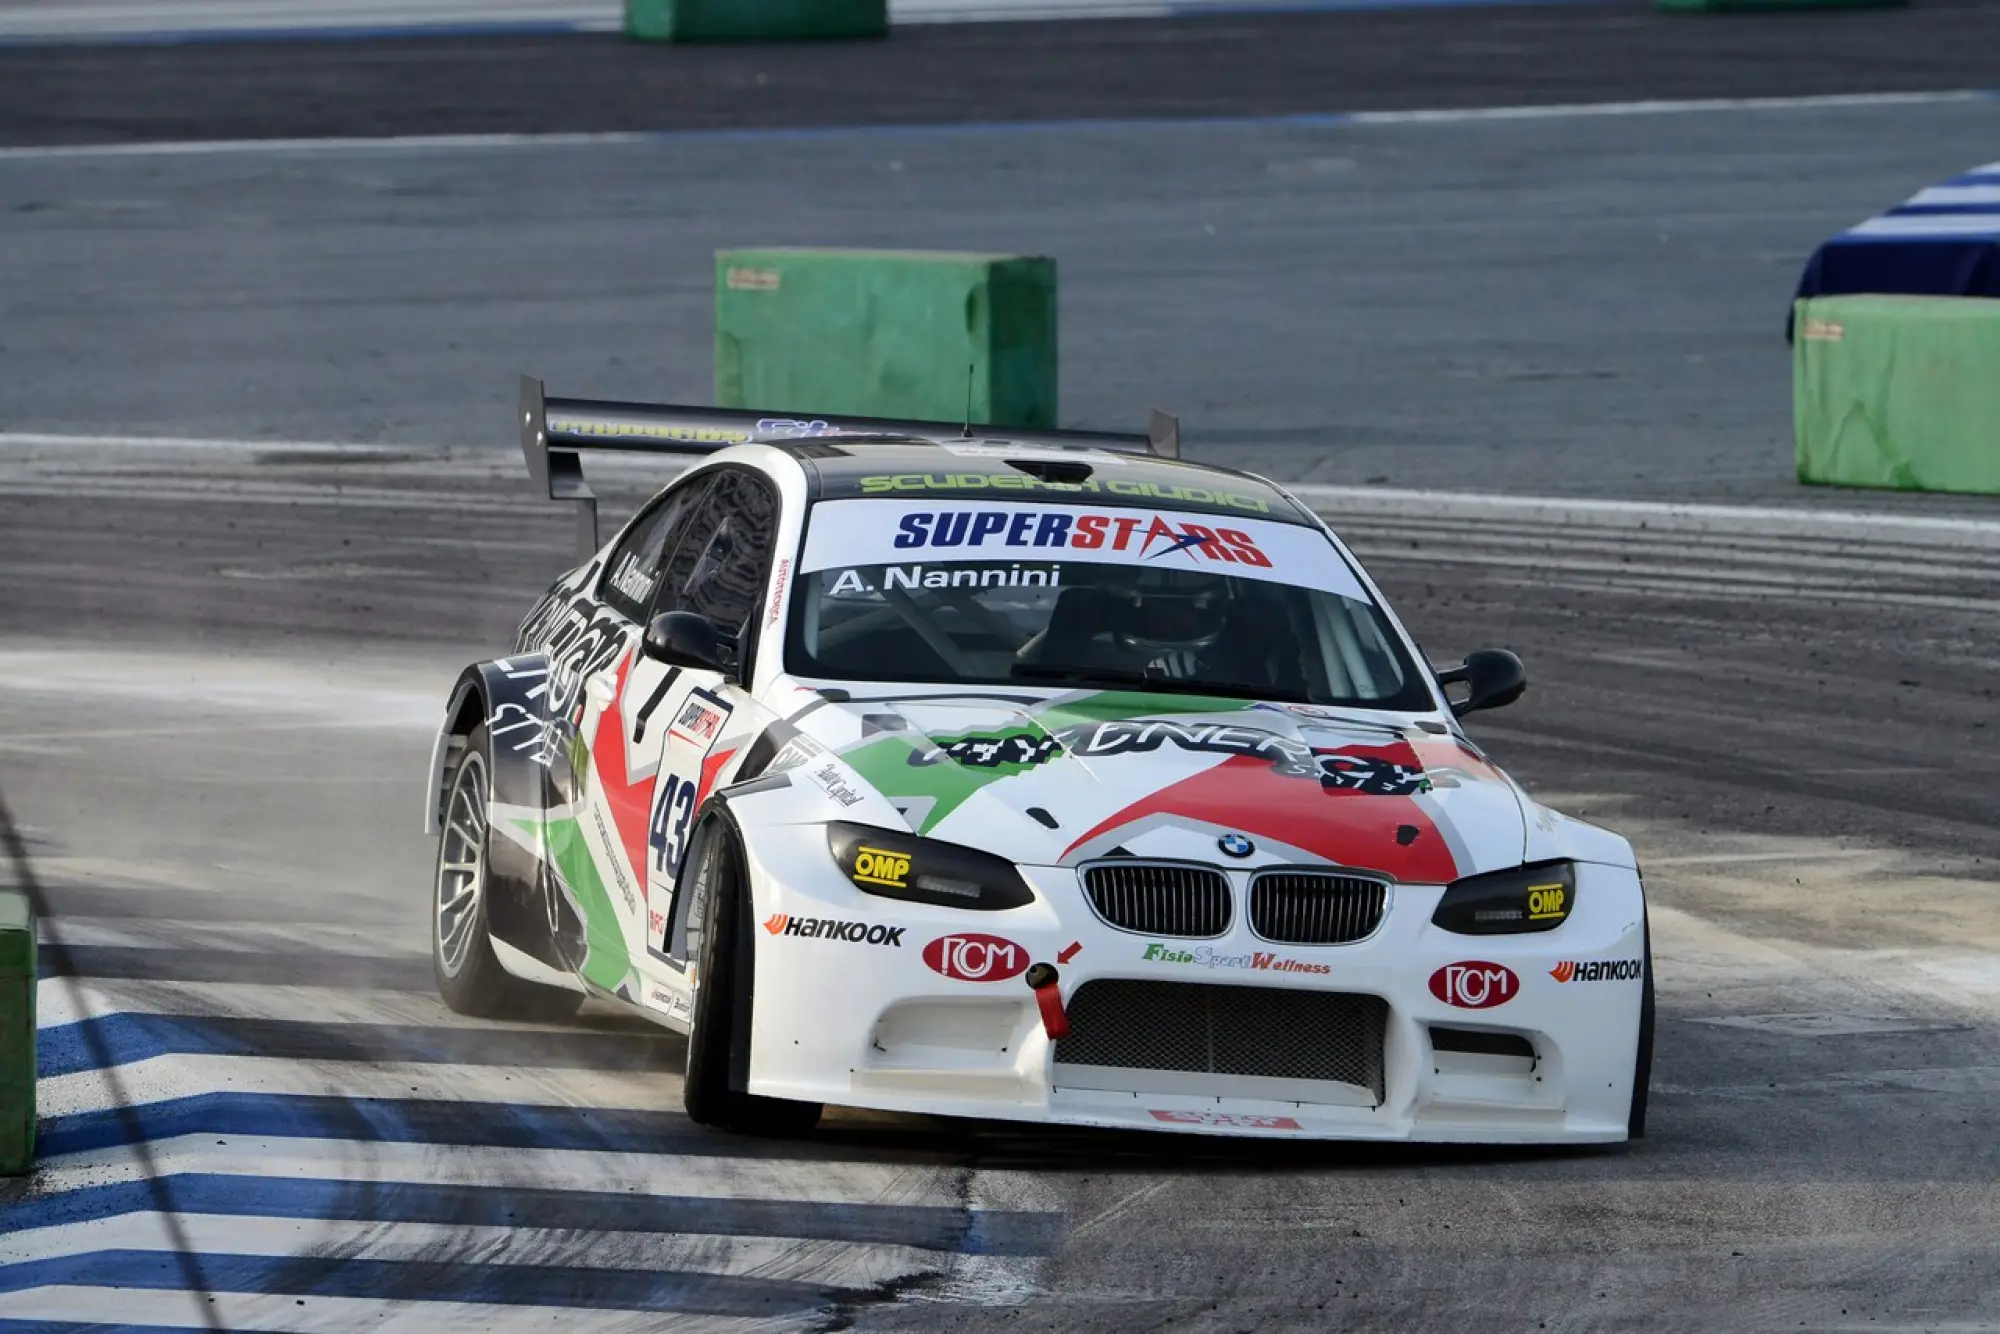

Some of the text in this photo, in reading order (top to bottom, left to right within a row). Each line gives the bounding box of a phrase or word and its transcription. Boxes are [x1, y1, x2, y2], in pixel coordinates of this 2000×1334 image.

[1105, 480, 1269, 513] GIUDICI
[893, 511, 1273, 568] SUPERSTARS
[829, 564, 1071, 595] A. Nannini
[649, 772, 697, 879] 43
[854, 853, 911, 881] OMP
[1528, 888, 1565, 914] OMP
